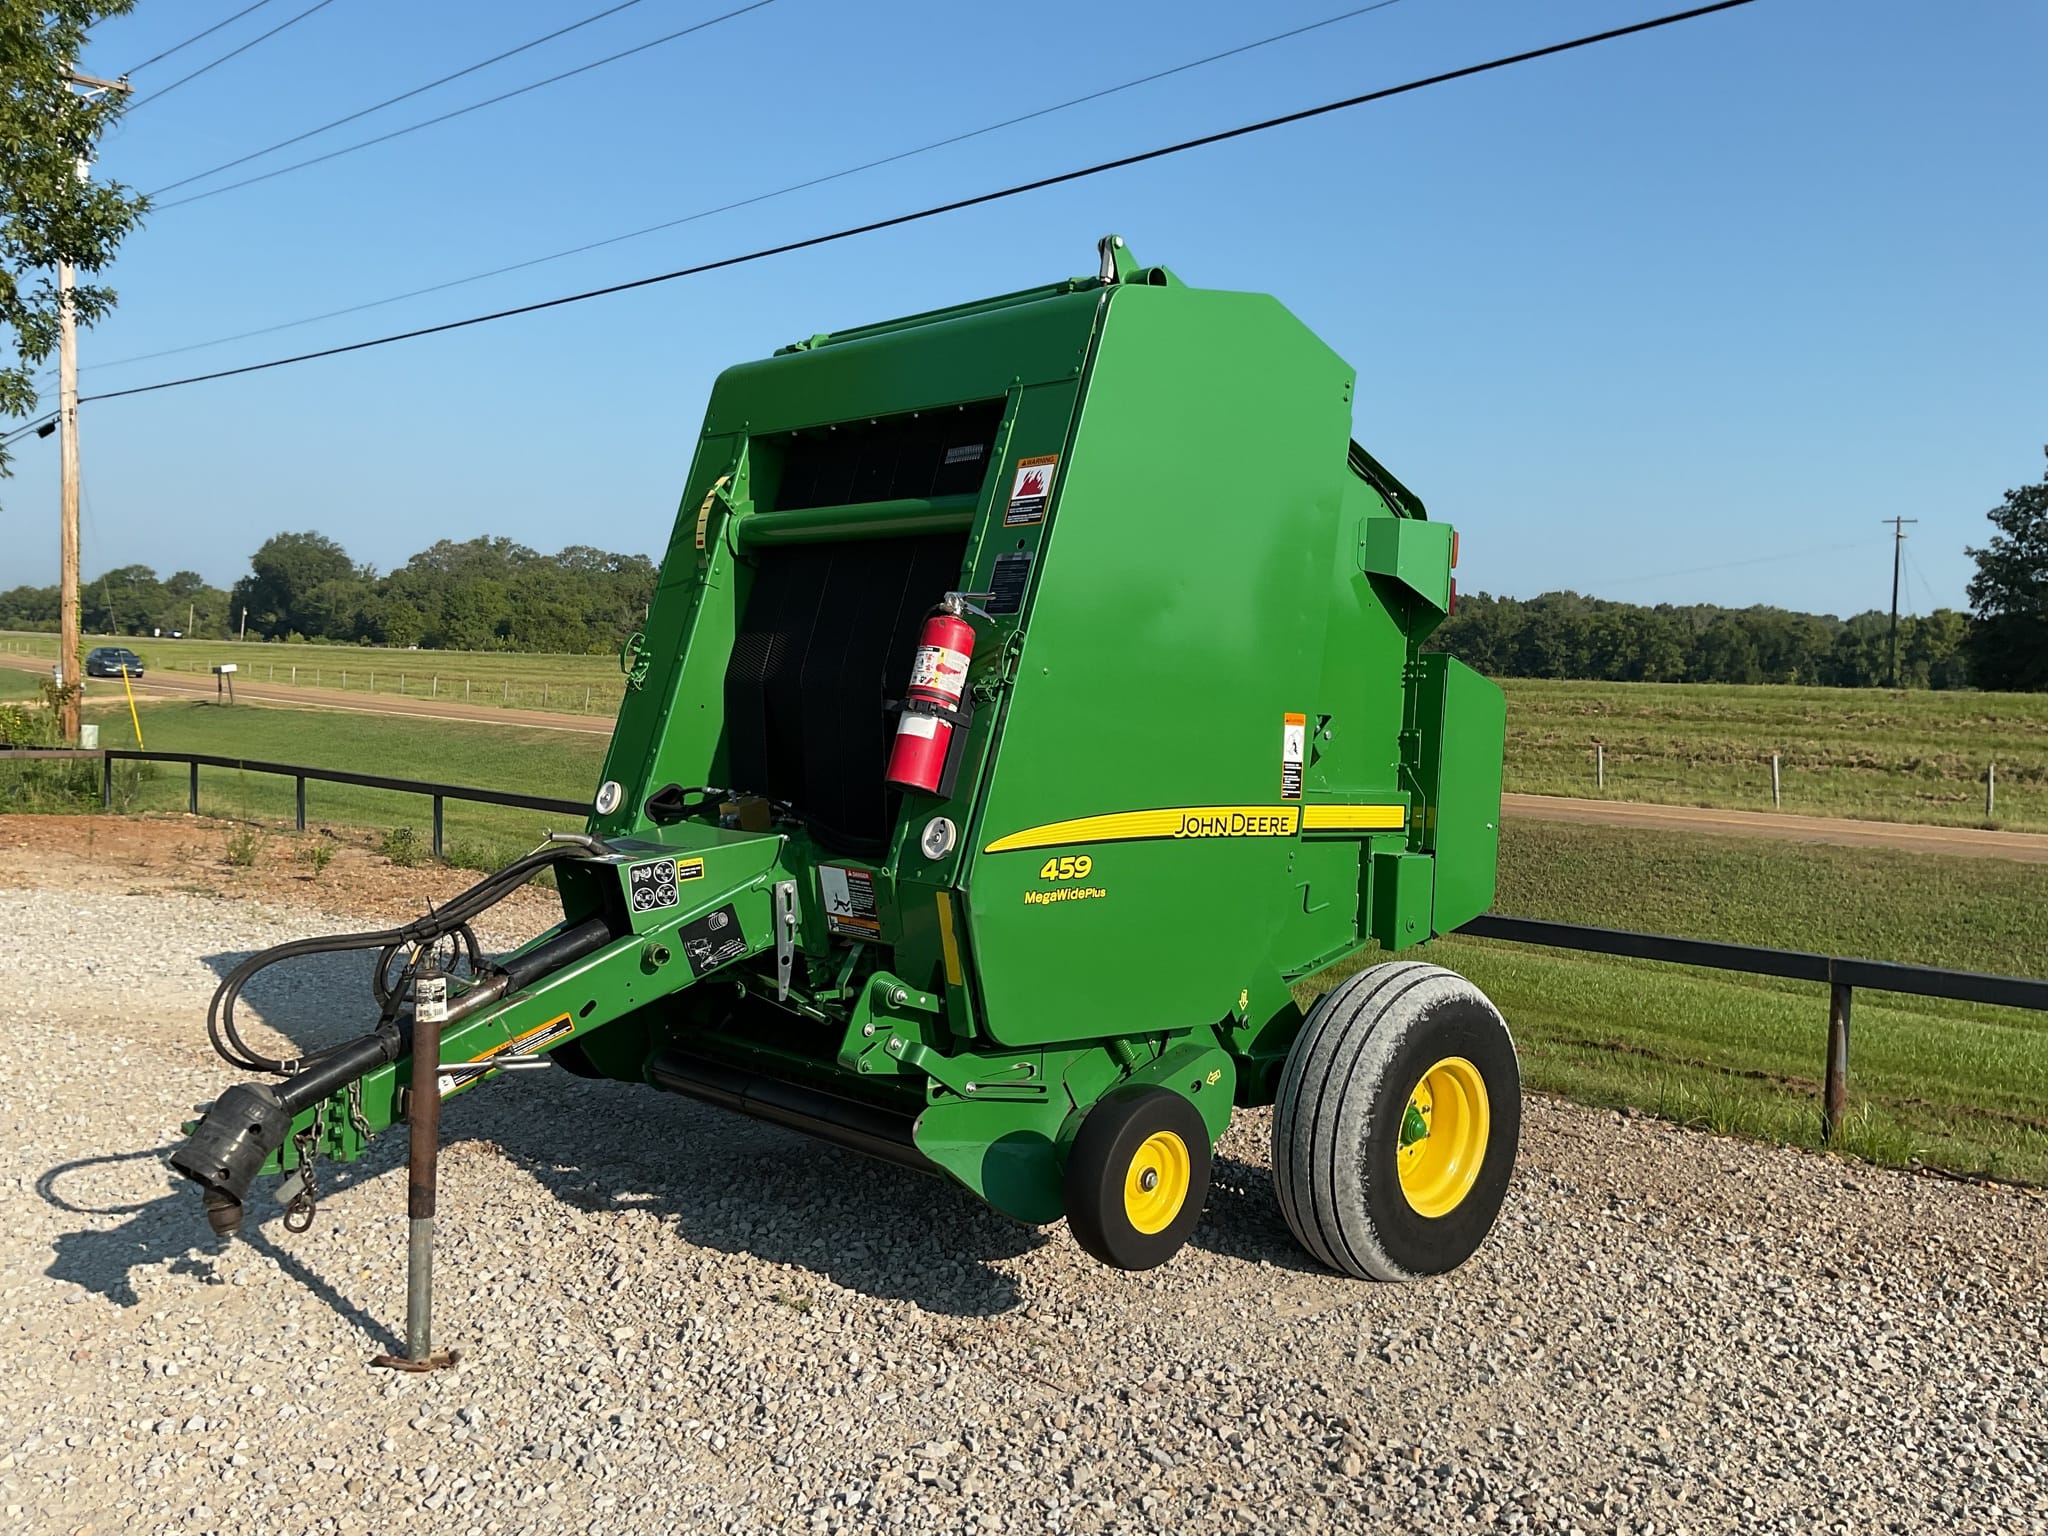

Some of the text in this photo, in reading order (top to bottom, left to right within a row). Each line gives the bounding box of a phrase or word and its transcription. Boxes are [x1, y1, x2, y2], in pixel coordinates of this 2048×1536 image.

[1174, 813, 1290, 835] JOHN DEERE
[1040, 855, 1093, 881] 459
[1024, 887, 1107, 905] MegaWidePlus
